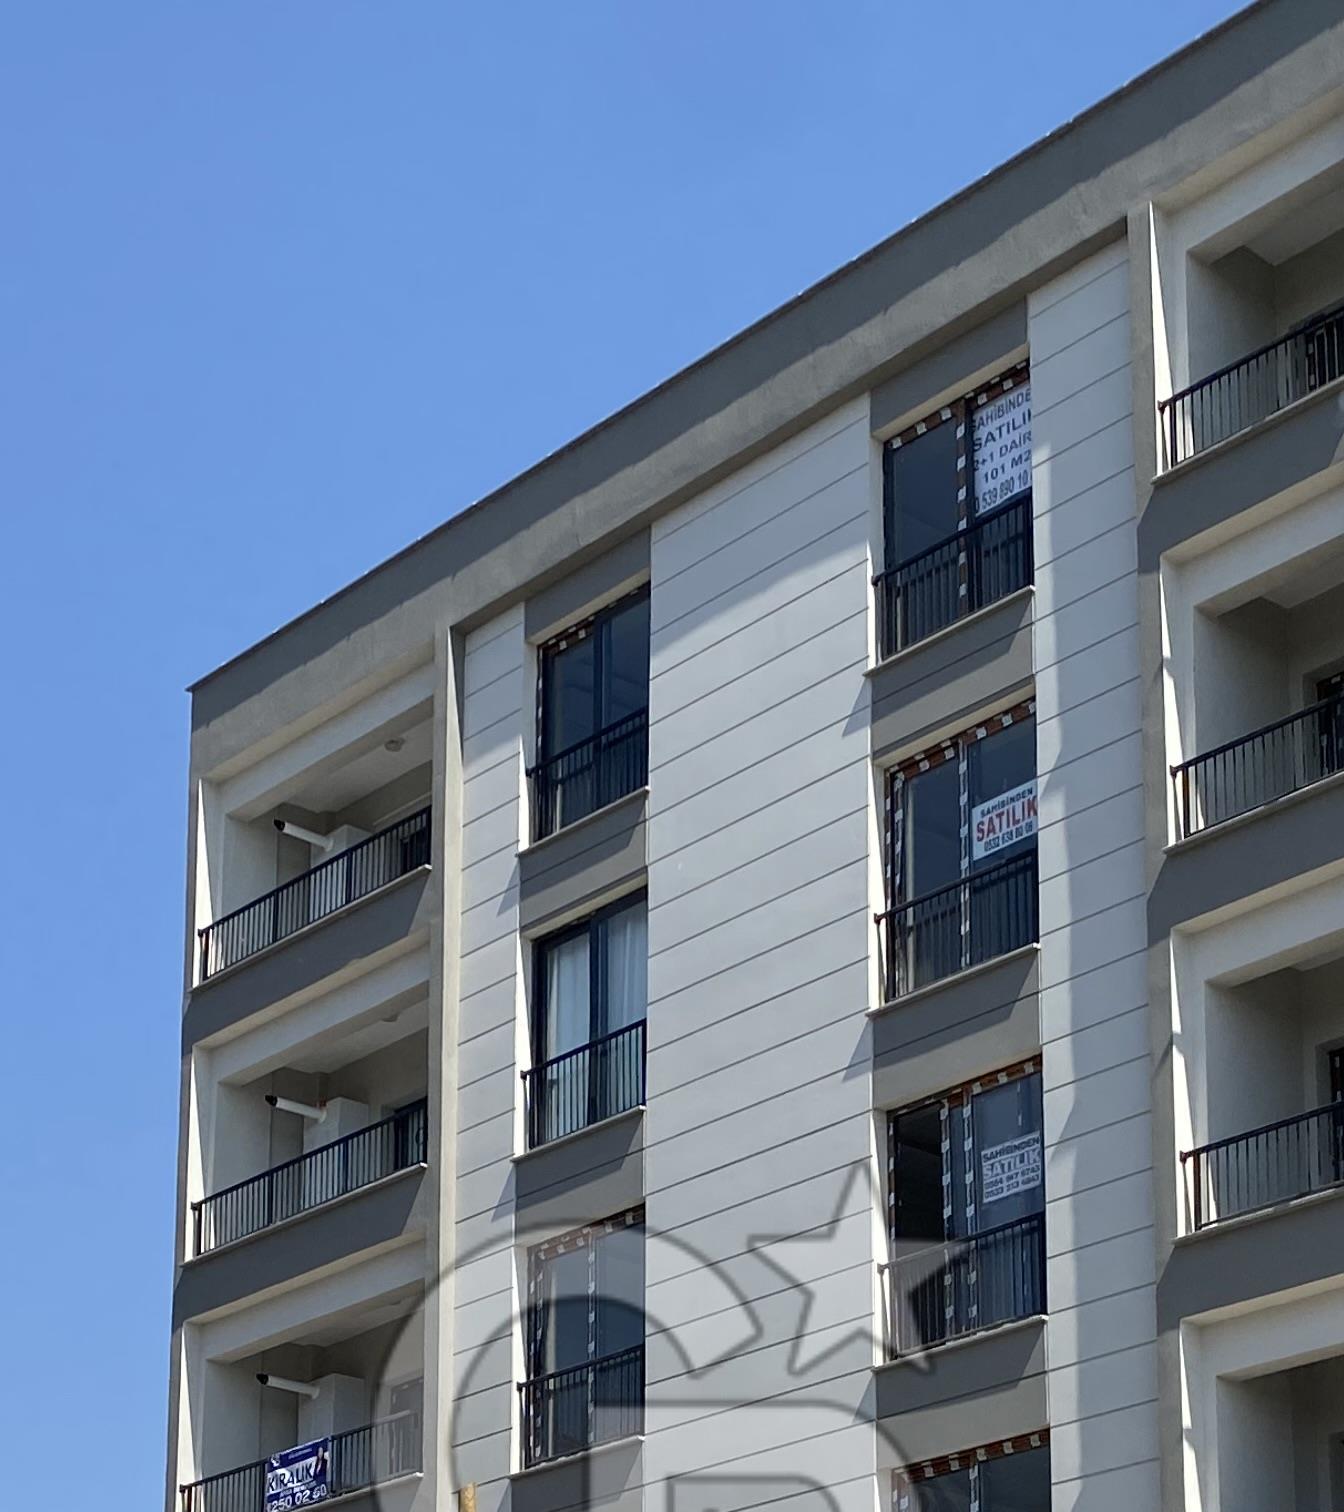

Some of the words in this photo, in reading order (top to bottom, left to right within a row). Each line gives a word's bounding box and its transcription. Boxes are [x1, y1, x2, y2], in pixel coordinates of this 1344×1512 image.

[984, 466, 1006, 483] 101
[977, 795, 1037, 841] SATILIK
[983, 1149, 1040, 1179] SATILIK
[272, 1496, 292, 1512] 250
[295, 1490, 310, 1504] 02
